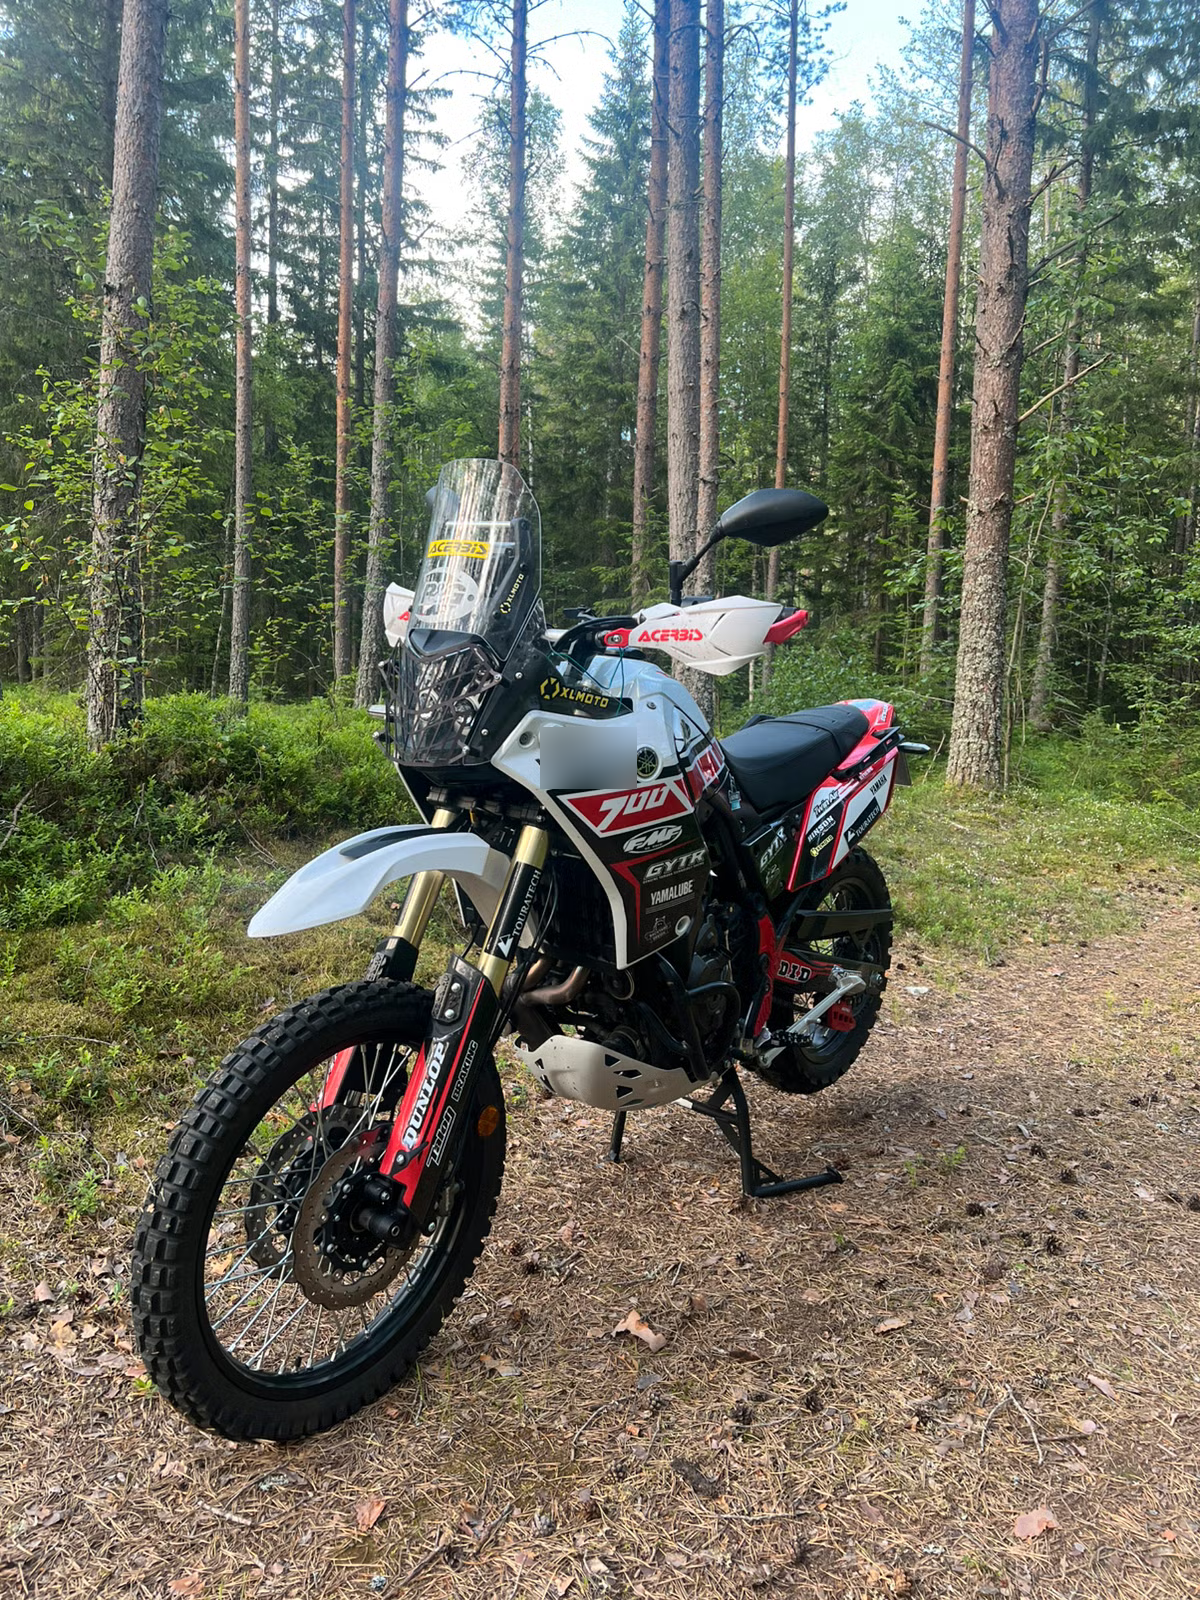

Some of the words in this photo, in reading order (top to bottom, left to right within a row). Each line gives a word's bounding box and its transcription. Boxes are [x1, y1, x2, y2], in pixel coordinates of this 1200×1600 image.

[507, 573, 525, 603] XLMOTO
[560, 686, 610, 709] XLMOTO
[869, 774, 888, 795] YAMAHA
[855, 805, 880, 837] TOURATECH
[624, 825, 683, 853] FMF
[760, 826, 788, 869] GYTR
[644, 849, 706, 879] GYTR
[512, 869, 542, 936] TOURATECH
[651, 879, 695, 906] YAMALUBE
[451, 1040, 479, 1102] BRAKING
[402, 1041, 445, 1151] DUNLOP
